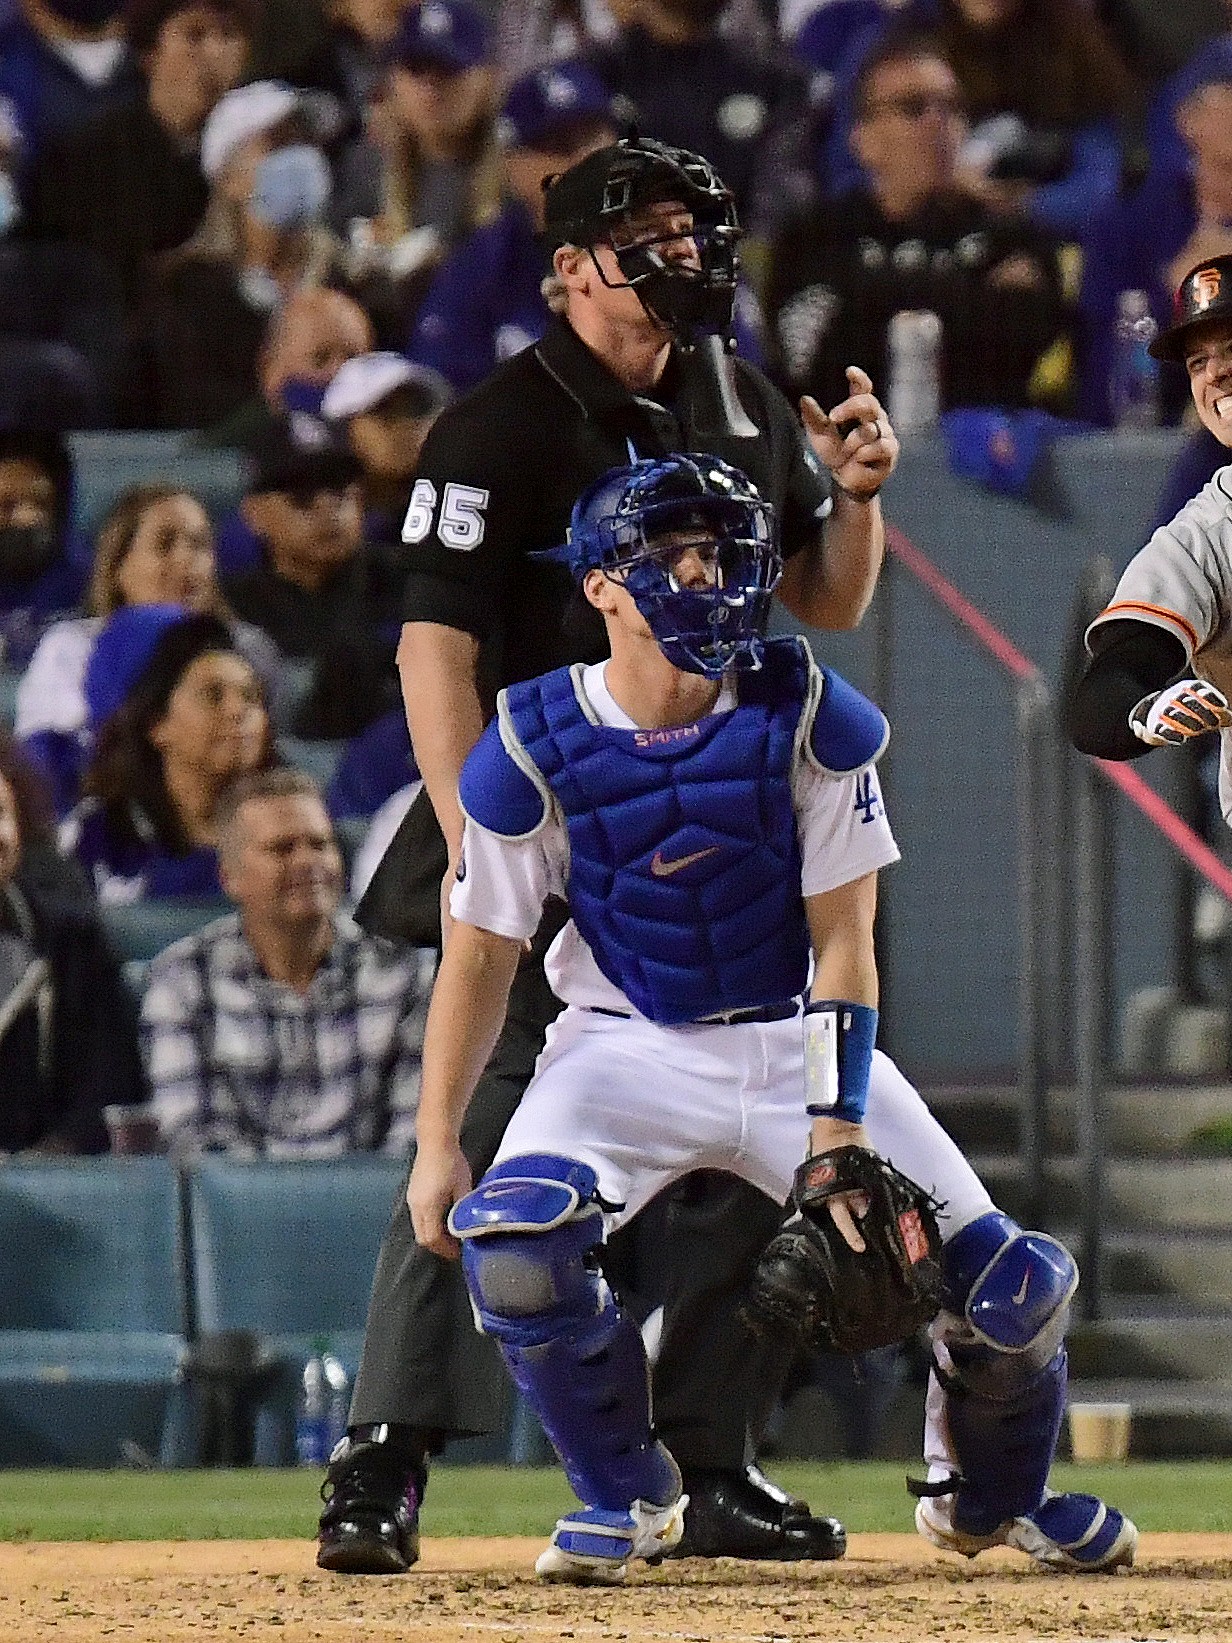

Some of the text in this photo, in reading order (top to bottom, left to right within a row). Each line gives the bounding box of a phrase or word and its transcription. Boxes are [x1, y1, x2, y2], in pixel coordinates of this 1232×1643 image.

[1193, 267, 1221, 311] SF
[401, 478, 490, 551] 65
[634, 724, 700, 747] SMITH
